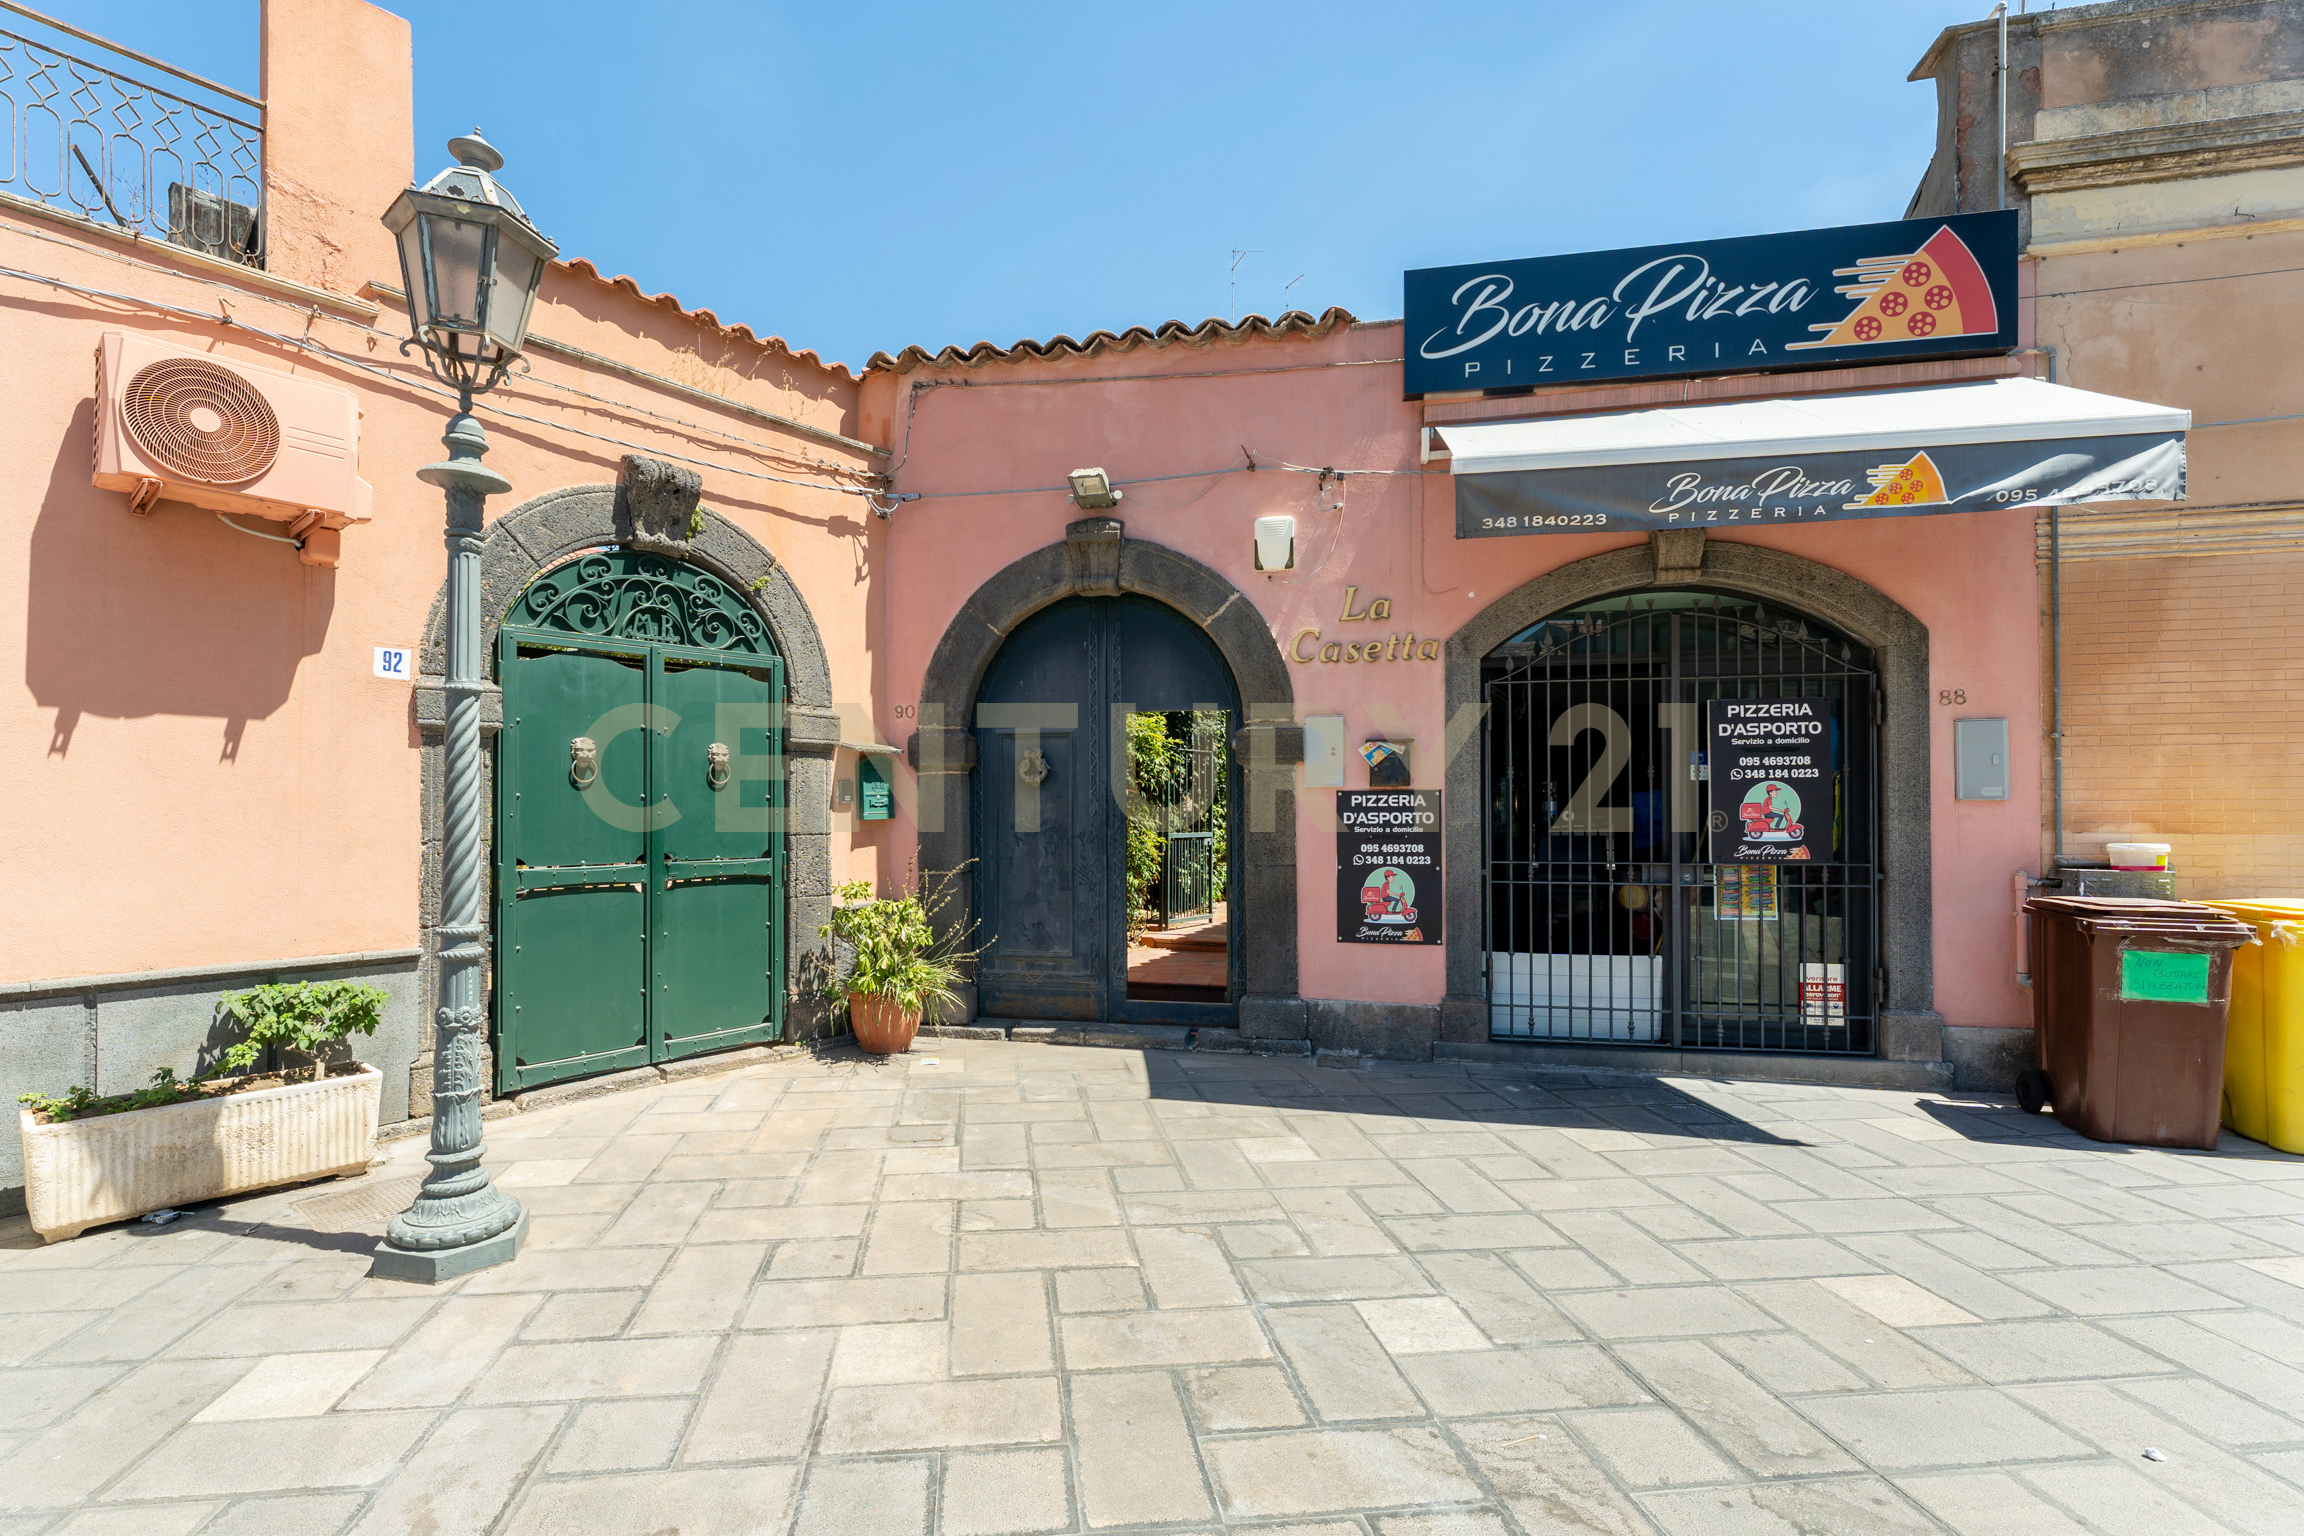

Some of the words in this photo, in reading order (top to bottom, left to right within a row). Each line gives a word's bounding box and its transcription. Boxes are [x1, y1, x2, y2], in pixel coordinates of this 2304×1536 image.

[1420, 275, 1617, 359] Bona
[1612, 254, 1819, 343] Pizza
[1465, 338, 1768, 378] PIZZERIA
[1648, 472, 1754, 513] Bona
[1751, 466, 1856, 507] Pizza
[1995, 488, 2038, 503] 095
[1482, 516, 1517, 529] 348
[1523, 513, 1607, 527] 1840223
[1668, 505, 1827, 523] PIZZERIA
[1339, 586, 1392, 621] La
[1289, 628, 1441, 663] Casetta
[382, 650, 403, 673] 92
[1940, 688, 1967, 706] 88
[894, 704, 916, 719] 90
[1727, 703, 1813, 718] PIZZERIA
[1718, 721, 1823, 737] D'ASPORTO
[1731, 737, 1765, 746] Servizio
[1774, 736, 1810, 745] domicilio
[1738, 757, 1761, 767] 095
[1762, 755, 1812, 766] 4693708
[1744, 769, 1766, 779] 348
[1768, 768, 1789, 778] 184
[1790, 768, 1820, 778] 0223
[1351, 794, 1427, 807] PIZZERIA
[1343, 811, 1435, 825] D'ASPORTO
[1360, 844, 1380, 853] 095
[1381, 843, 1425, 853] 4693708
[1733, 844, 1761, 857] Bona
[1760, 844, 1787, 857] Pizza
[1365, 855, 1385, 865] 348
[1386, 855, 1405, 865] 184
[1406, 855, 1432, 865] 0223
[1355, 926, 1380, 938] Bona
[1378, 926, 1403, 937] Pizza
[2134, 957, 2165, 968] NON
[2153, 968, 2201, 979] BUTTARE
